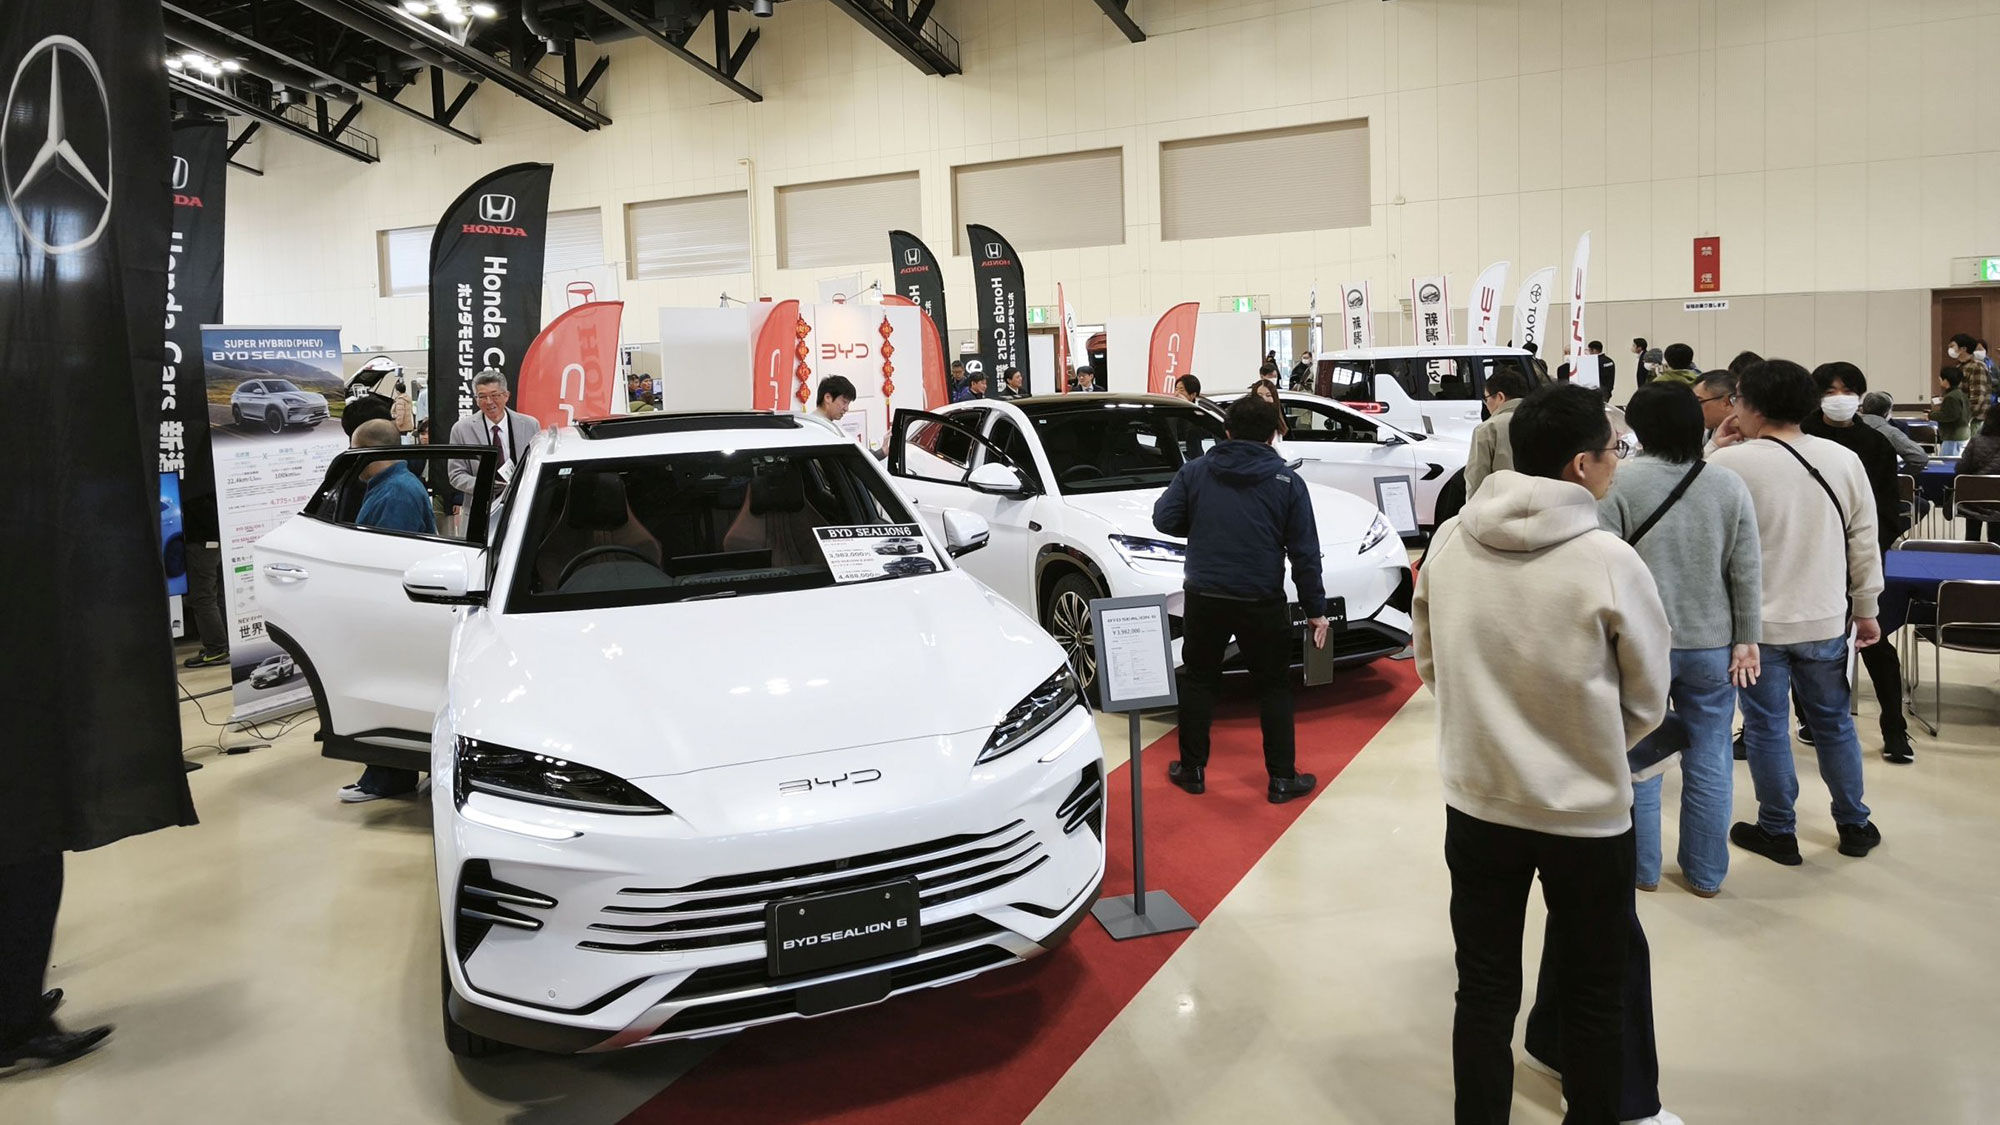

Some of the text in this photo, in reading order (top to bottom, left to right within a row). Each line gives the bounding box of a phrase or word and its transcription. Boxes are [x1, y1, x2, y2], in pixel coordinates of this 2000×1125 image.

[462, 224, 528, 237] HONDA
[483, 256, 508, 338] Honda
[224, 339, 324, 348] SUPER HYBRID(PHEV)
[821, 343, 869, 359] BYD
[212, 350, 336, 361] BYD SEALION 6
[1163, 333, 1180, 394] BYD
[828, 526, 912, 538] BYD SEALION6
[239, 622, 263, 639] 世界
[779, 768, 882, 797] BYD
[783, 917, 907, 950] BYD SEALION 6
